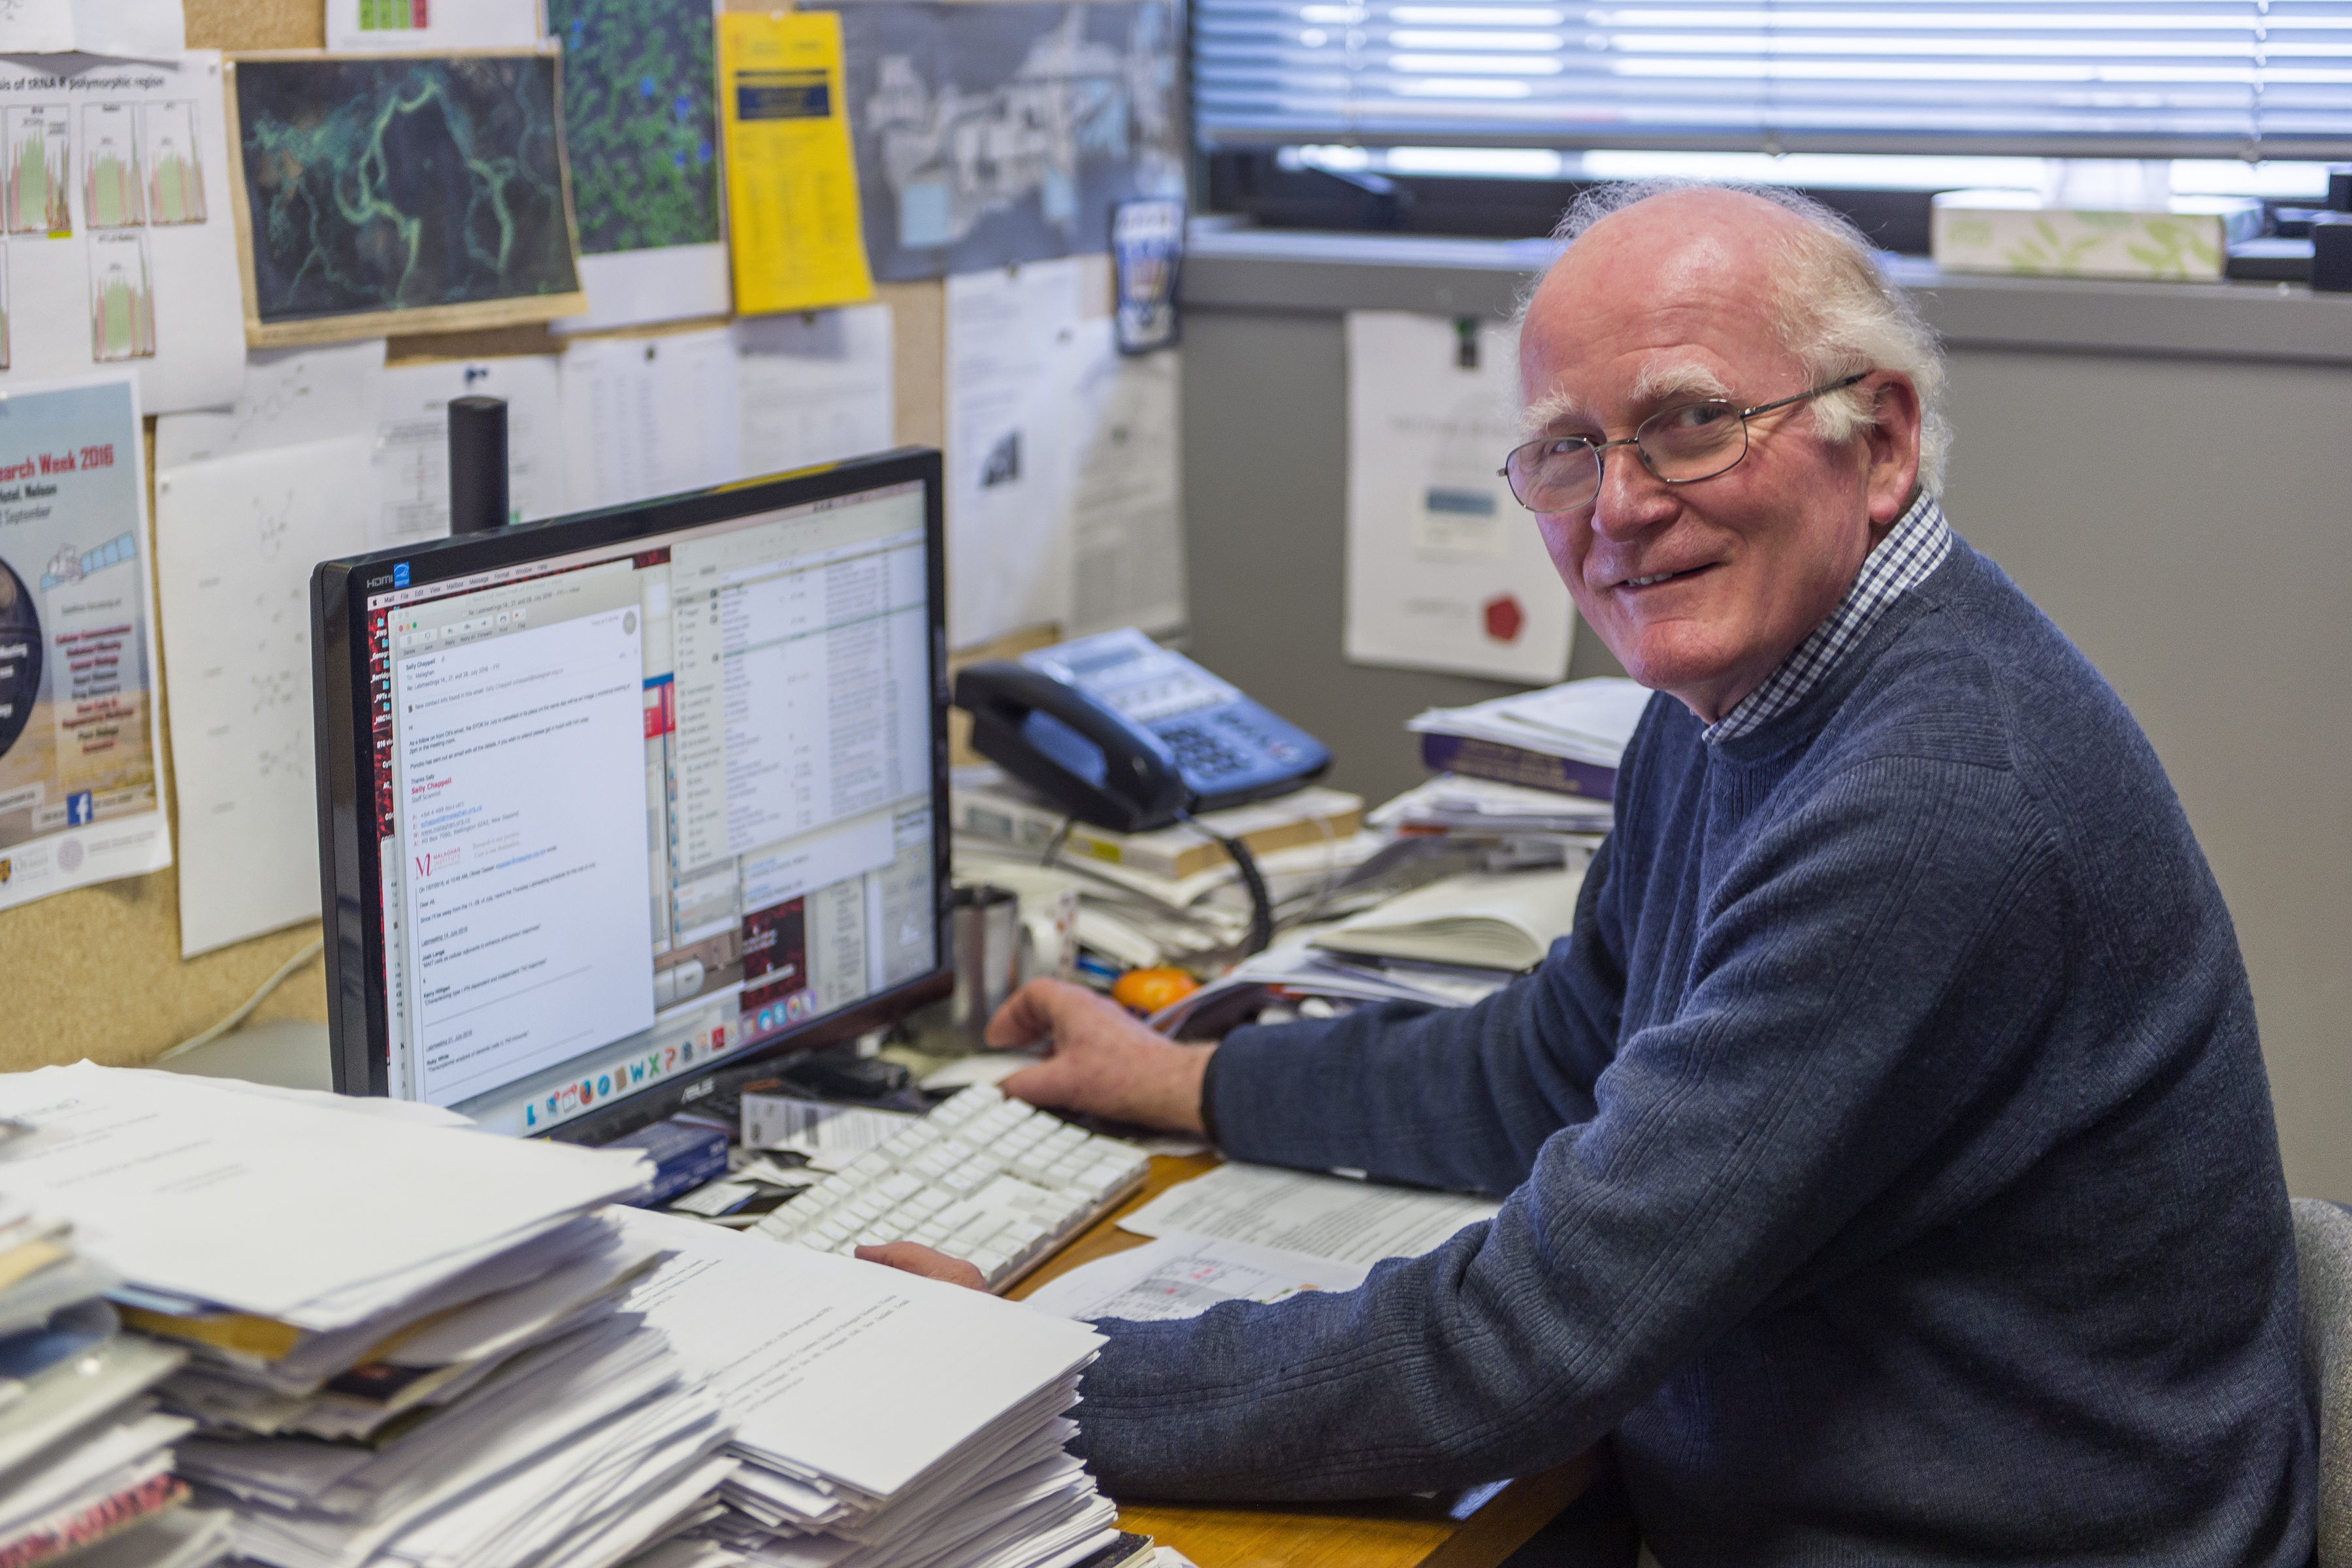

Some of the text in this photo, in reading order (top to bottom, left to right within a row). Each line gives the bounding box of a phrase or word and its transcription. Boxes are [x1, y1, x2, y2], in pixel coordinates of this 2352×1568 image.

[69, 76, 130, 92] polymorphic
[134, 76, 164, 90] region
[39, 448, 76, 476] Week
[80, 443, 114, 470] 2016
[384, 595, 395, 604] Mail
[415, 589, 424, 597] Edit
[429, 585, 440, 595] View
[446, 581, 464, 591] Mailbox
[469, 576, 489, 586] Message
[494, 570, 510, 580] Format
[515, 566, 532, 576] Window
[537, 563, 547, 571] Help
[533, 593, 542, 602] July
[406, 657, 436, 671] Sally Chappell
[415, 669, 435, 679] Malaghan
[414, 678, 440, 690] Labmeetings
[425, 698, 440, 708] contact
[429, 740, 446, 750] meeting
[454, 749, 465, 757] email
[411, 773, 434, 785] Thanks Sally
[412, 777, 452, 795] Sally Chappell
[412, 790, 441, 804] Staff Scientist
[435, 806, 444, 815] 499
[453, 824, 476, 836] Wellington
[501, 809, 519, 821] Zealand
[433, 847, 461, 860] MALAGHAN
[433, 854, 461, 866] INSTITUTE
[630, 1060, 644, 1083] W
